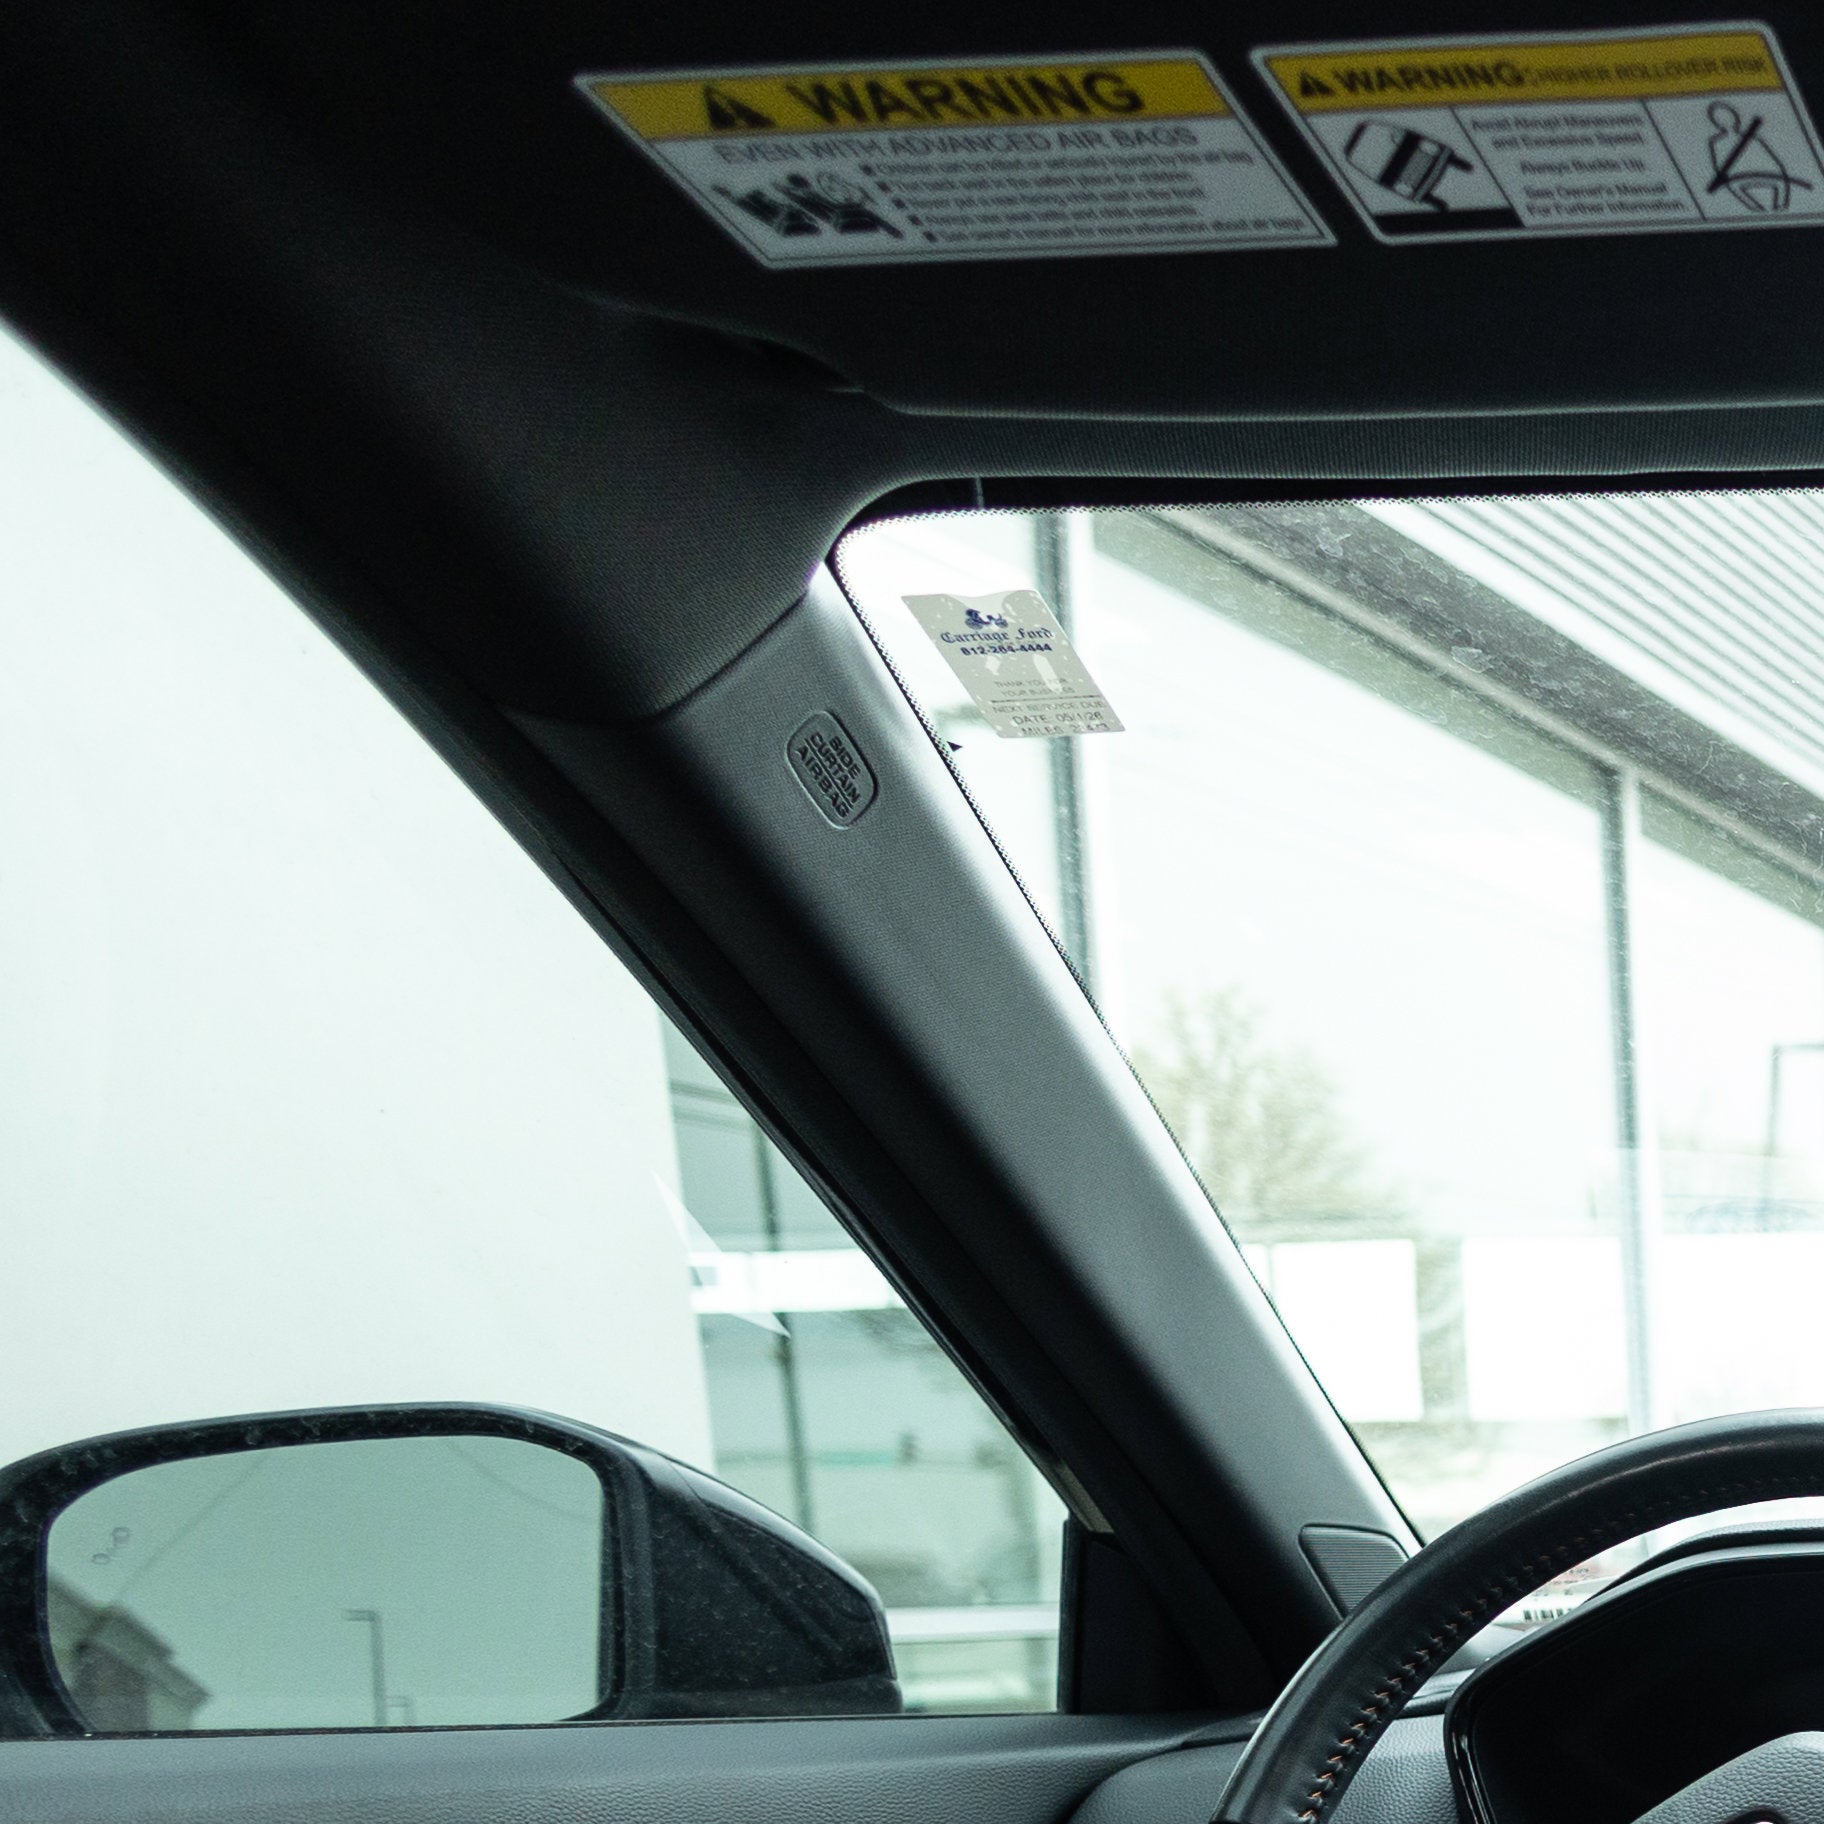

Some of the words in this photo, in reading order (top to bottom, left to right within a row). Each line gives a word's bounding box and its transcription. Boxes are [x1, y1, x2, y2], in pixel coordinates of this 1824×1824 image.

[786, 70, 1146, 131] WARNING
[709, 141, 806, 164] EVEN
[798, 138, 890, 160] WITH
[880, 131, 1057, 156] ADVANCED
[1047, 128, 1112, 150] AIR
[1105, 125, 1203, 147] BAGS
[940, 632, 1009, 644] Carriage
[1015, 627, 1056, 640] Ford
[795, 745, 851, 819] AIRBAG
[810, 731, 862, 804] CURTAIN
[828, 735, 861, 780] SIDE
